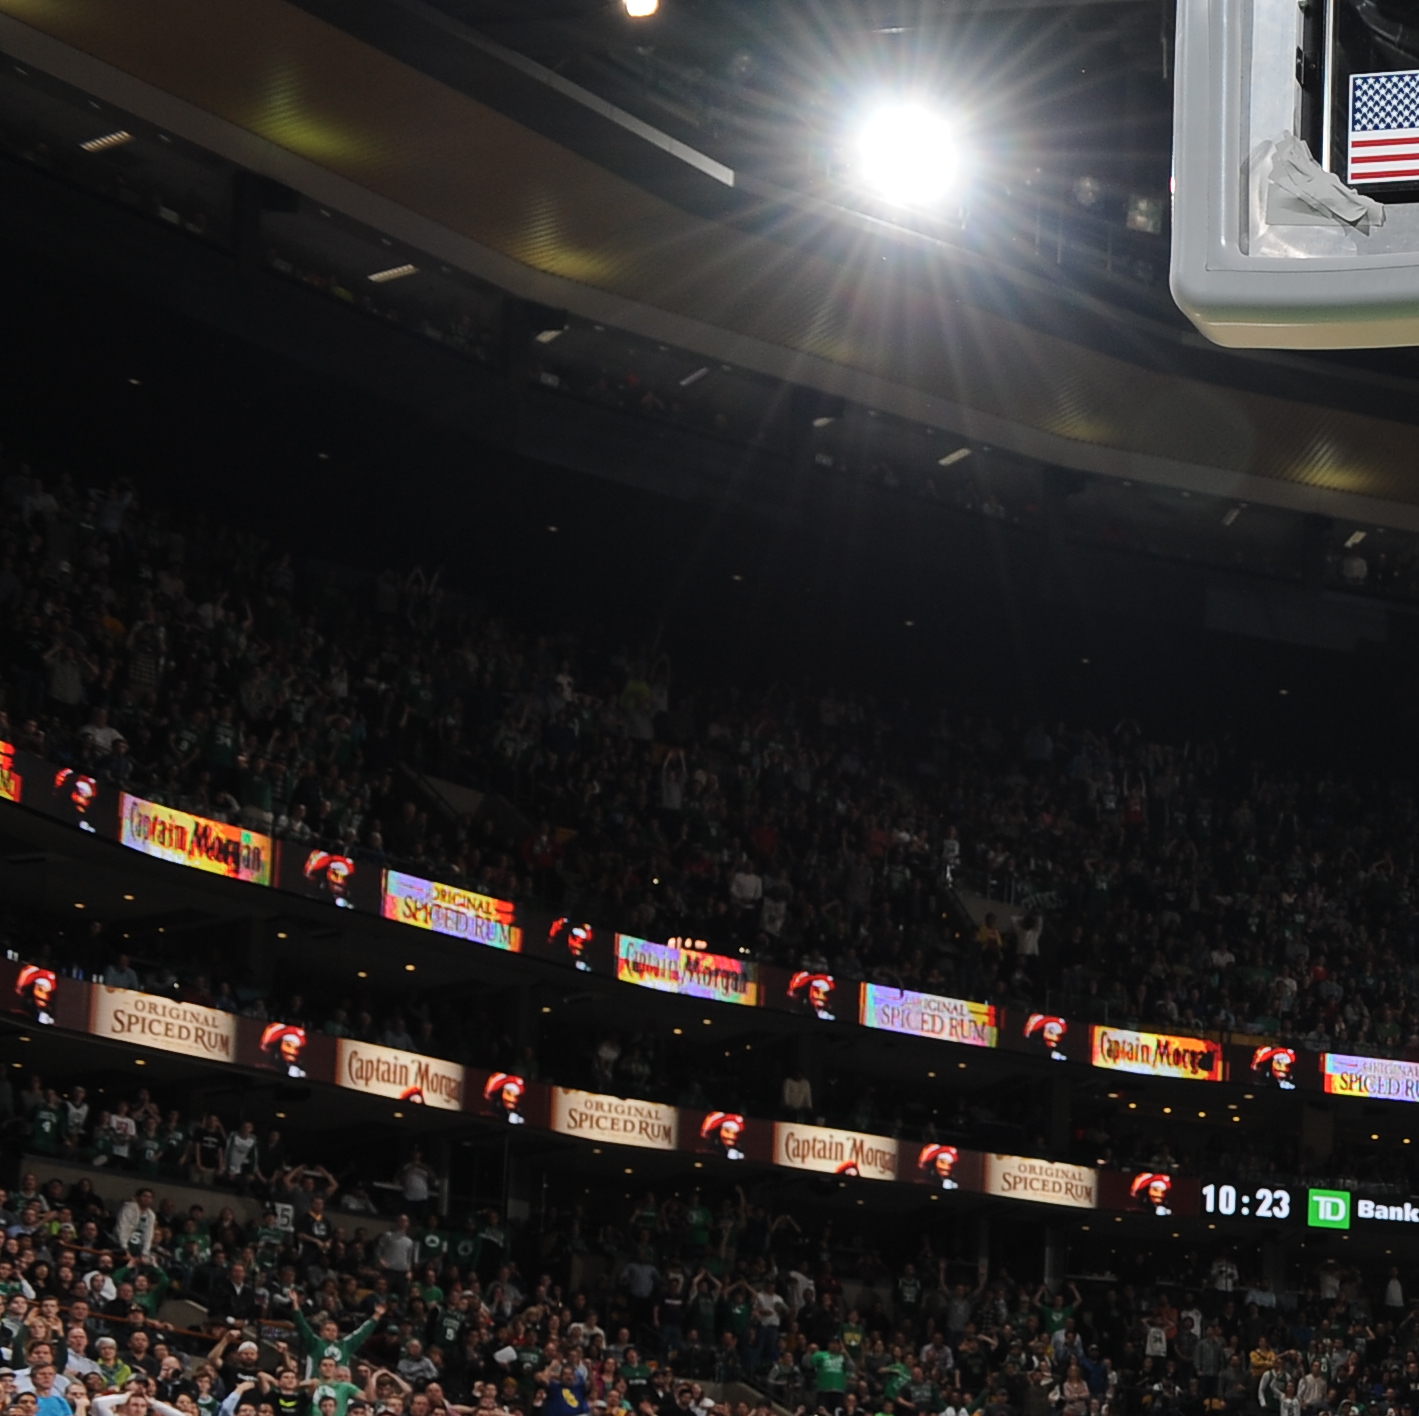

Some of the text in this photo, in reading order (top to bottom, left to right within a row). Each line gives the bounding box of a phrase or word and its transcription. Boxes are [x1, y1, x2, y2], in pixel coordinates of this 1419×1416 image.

[133, 998, 219, 1030] ORIGINAL
[880, 1003, 988, 1043] SPICED RUM
[110, 1009, 230, 1057] SPICED RUM
[1099, 1031, 1151, 1063] Captain
[346, 1049, 411, 1087] Captain
[1339, 1073, 1401, 1097] SPICED
[583, 1098, 662, 1122] ORIGINAL
[565, 1108, 674, 1145] SPICED RUM
[783, 1130, 845, 1164] Captain
[1000, 1172, 1098, 1203] SPICED RUM
[1016, 1162, 1086, 1182] ORIGINAL
[1201, 1183, 1291, 1219] 10:23
[1312, 1195, 1347, 1222] TD
